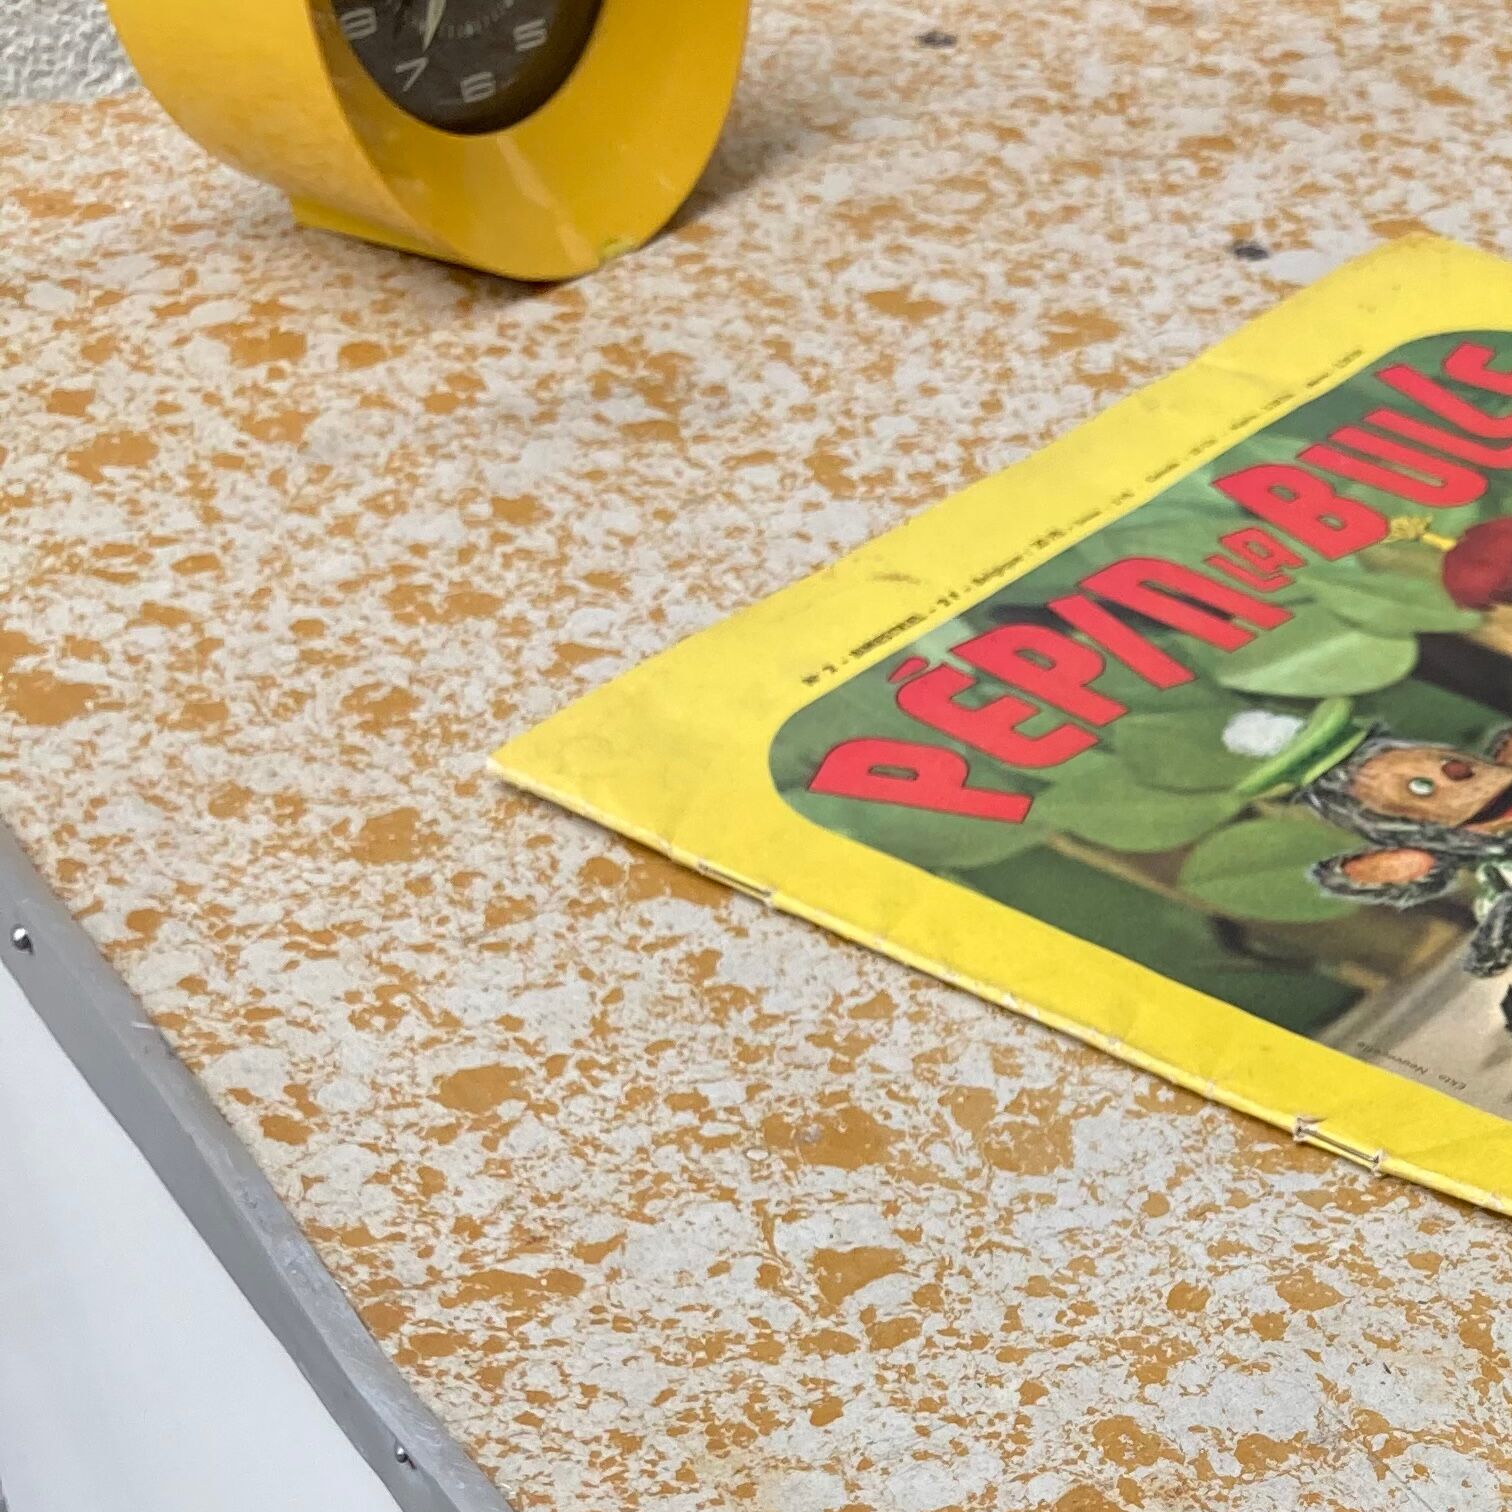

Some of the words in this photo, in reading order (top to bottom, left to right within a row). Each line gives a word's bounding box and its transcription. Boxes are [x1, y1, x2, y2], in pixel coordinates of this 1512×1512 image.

[513, 18, 548, 51] 5
[395, 57, 429, 92] 7
[460, 71, 496, 103] 6
[807, 556, 1295, 824] PÉPIN
